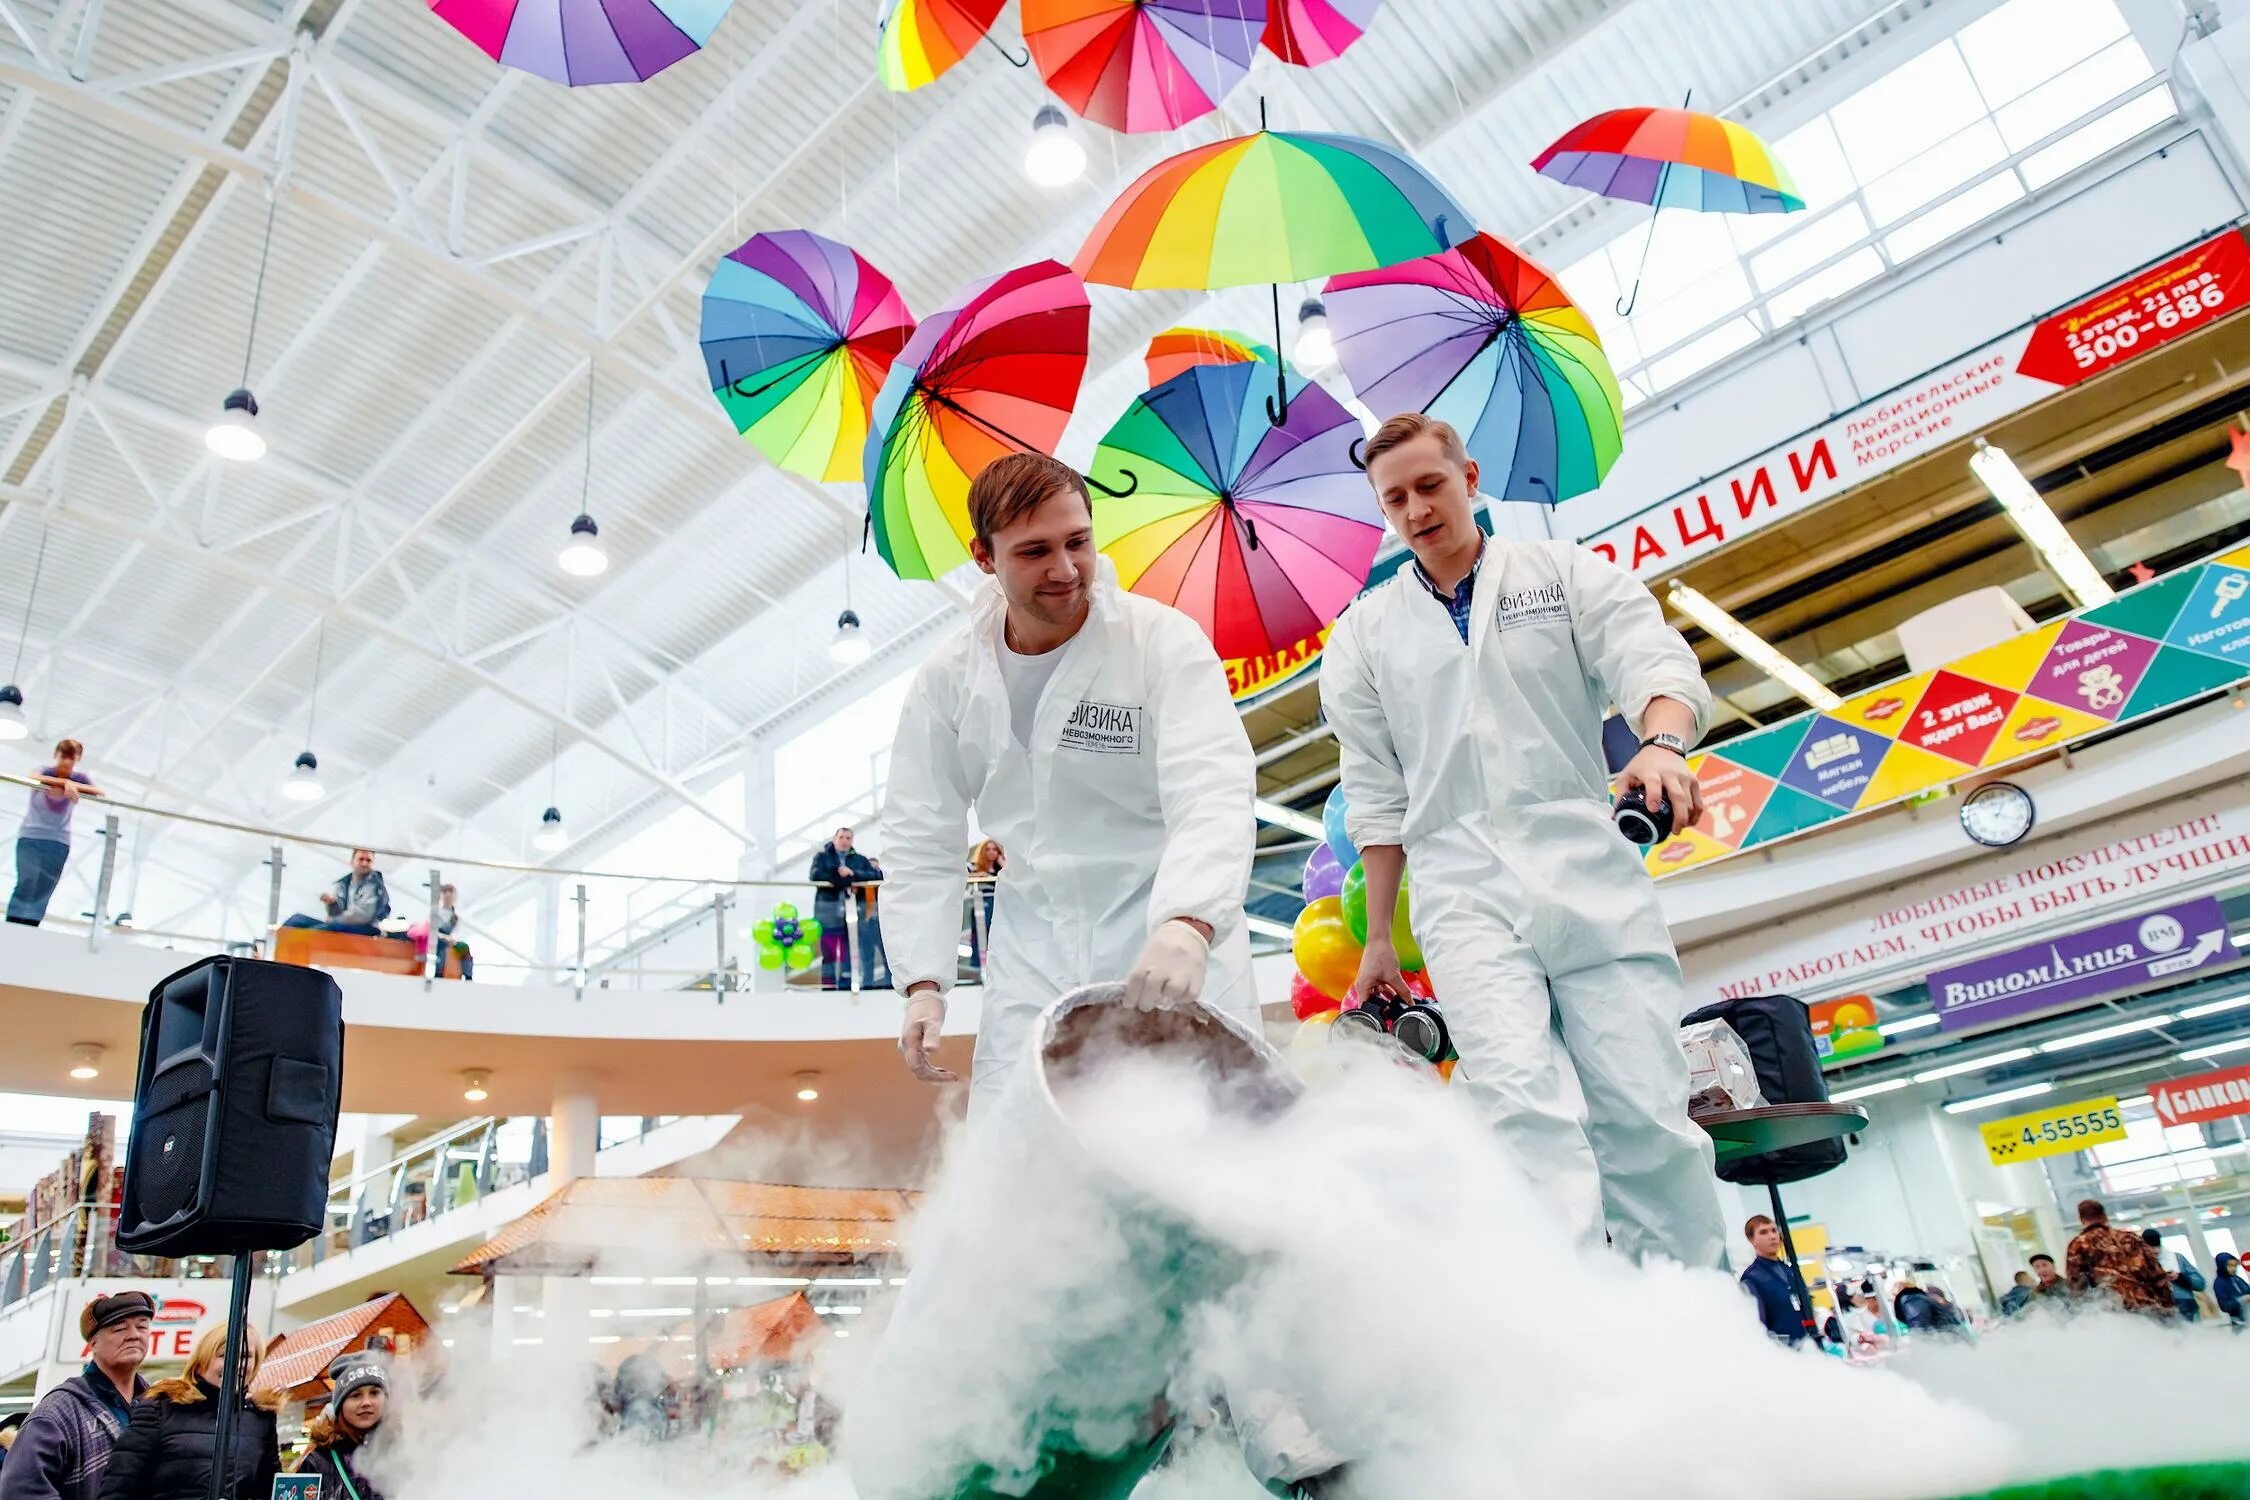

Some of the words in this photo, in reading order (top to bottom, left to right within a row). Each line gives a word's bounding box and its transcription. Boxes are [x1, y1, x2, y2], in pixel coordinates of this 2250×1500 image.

[2065, 332, 2081, 349] 2
[2081, 308, 2141, 342] этаж,
[2141, 291, 2170, 313] 21
[2171, 271, 2222, 299] пав.
[2073, 283, 2225, 368] 500-686
[1847, 355, 2005, 438] Любительские
[1853, 375, 2003, 451] Авиационные
[1857, 416, 1952, 466] Морские
[1500, 584, 1566, 611] ФИЗИКА
[2052, 658, 2081, 678] для
[2083, 638, 2129, 667] детей
[2054, 630, 2112, 657] Товары
[1919, 709, 1937, 728] 2
[1940, 692, 1993, 722] этаж
[1920, 721, 1965, 747] ждет
[1966, 706, 2005, 731] Вас!
[1062, 727, 1134, 743] НЕВОЗМОЖНОГО
[1817, 758, 1863, 782] Мягкая
[1821, 774, 1870, 797] мебель
[1870, 878, 2012, 932] ЛЮБИМЫЕ
[2016, 814, 2222, 888] ПОКУПАТЕЛИ!
[1718, 976, 1763, 1001] МЫ
[1768, 935, 1916, 989] РАБОТАЕМ,
[1920, 900, 2024, 944] ЧТОБЫ
[2031, 877, 2117, 914] БЫТЬ
[2021, 1108, 2121, 1146] 4-55555
